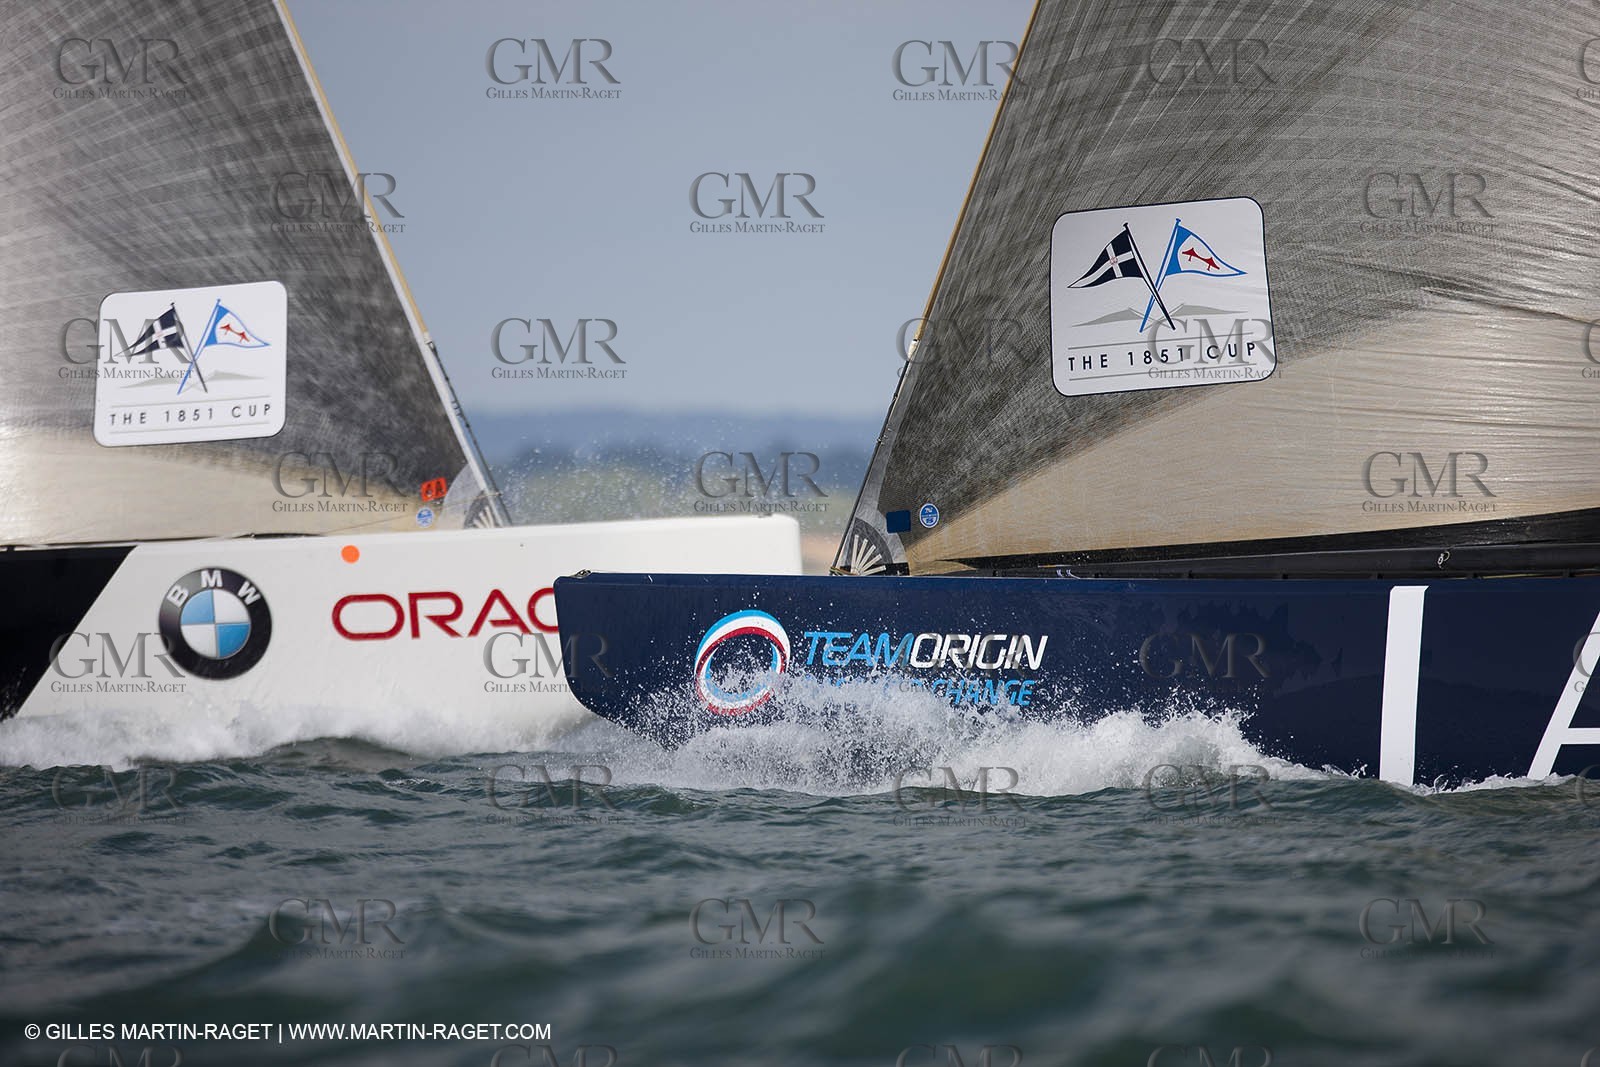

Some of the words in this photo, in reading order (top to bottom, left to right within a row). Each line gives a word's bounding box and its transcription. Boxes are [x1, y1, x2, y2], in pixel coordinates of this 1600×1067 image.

[1068, 354, 1108, 371] THE
[1128, 348, 1184, 366] 1851
[1207, 342, 1255, 360] CUP
[110, 412, 147, 425] THE
[165, 409, 213, 422] 1851
[232, 404, 271, 418] CUP
[166, 569, 261, 608] BMW
